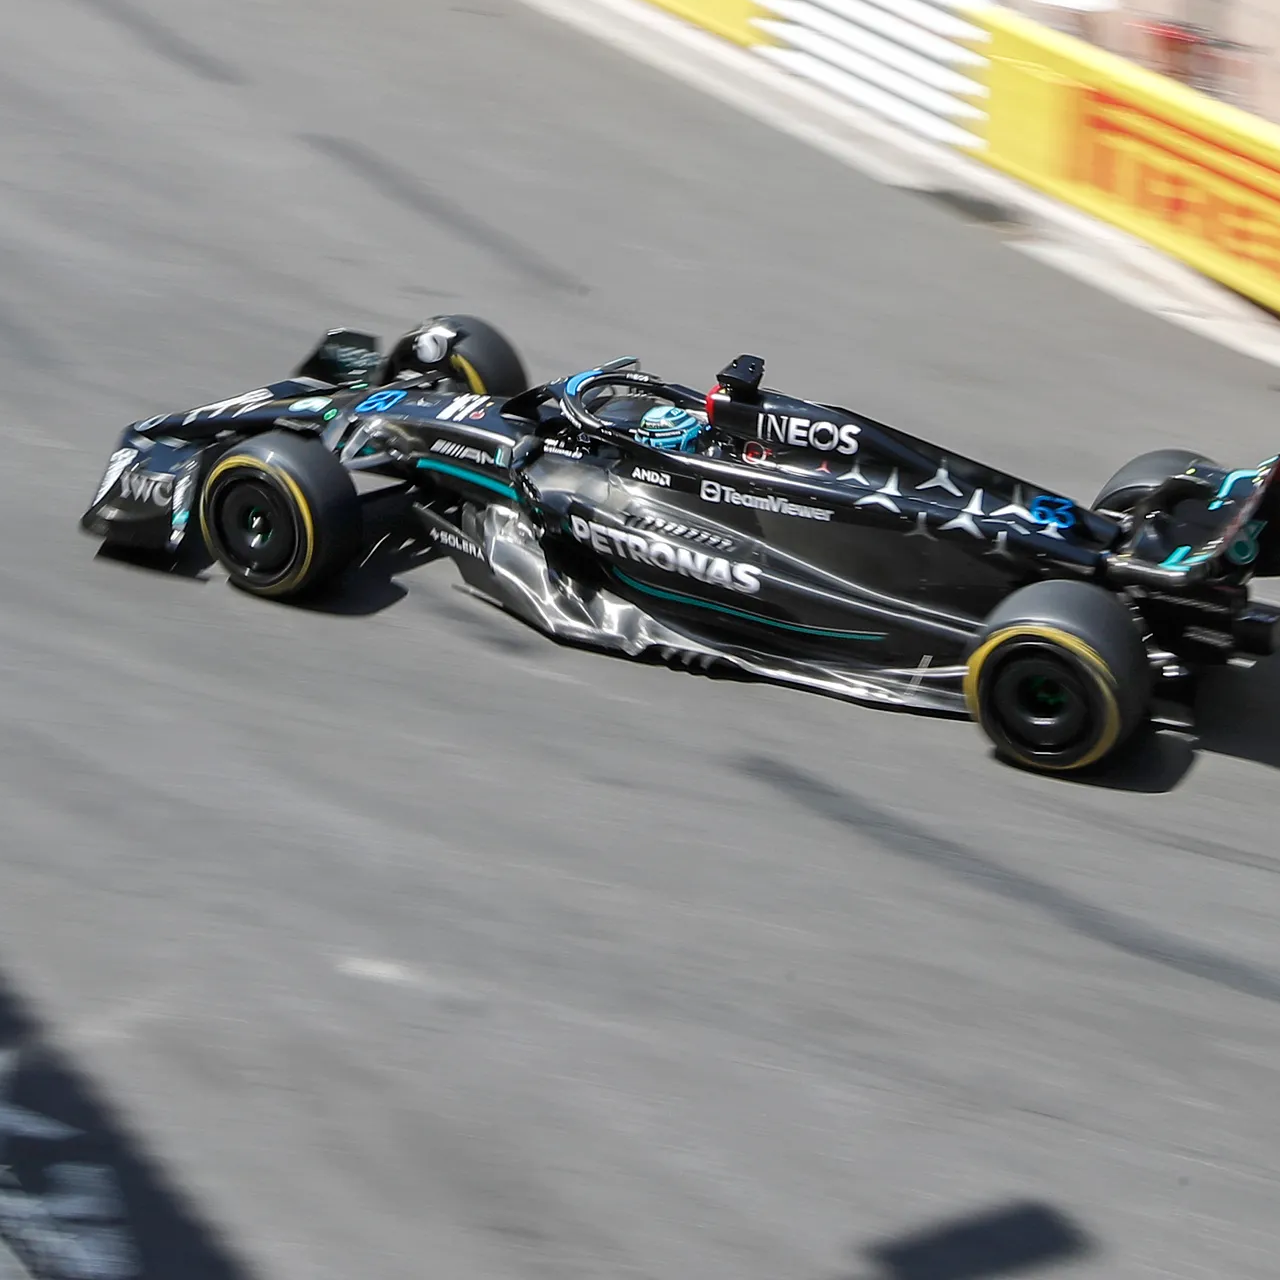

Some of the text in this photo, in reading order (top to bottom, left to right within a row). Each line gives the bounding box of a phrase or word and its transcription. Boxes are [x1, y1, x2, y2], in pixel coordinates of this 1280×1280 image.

[756, 412, 862, 455] INEOS
[720, 486, 835, 522] TeamViewer
[1030, 494, 1075, 529] 63
[440, 531, 485, 562] SOLERA
[570, 514, 763, 595] PETRONAS
